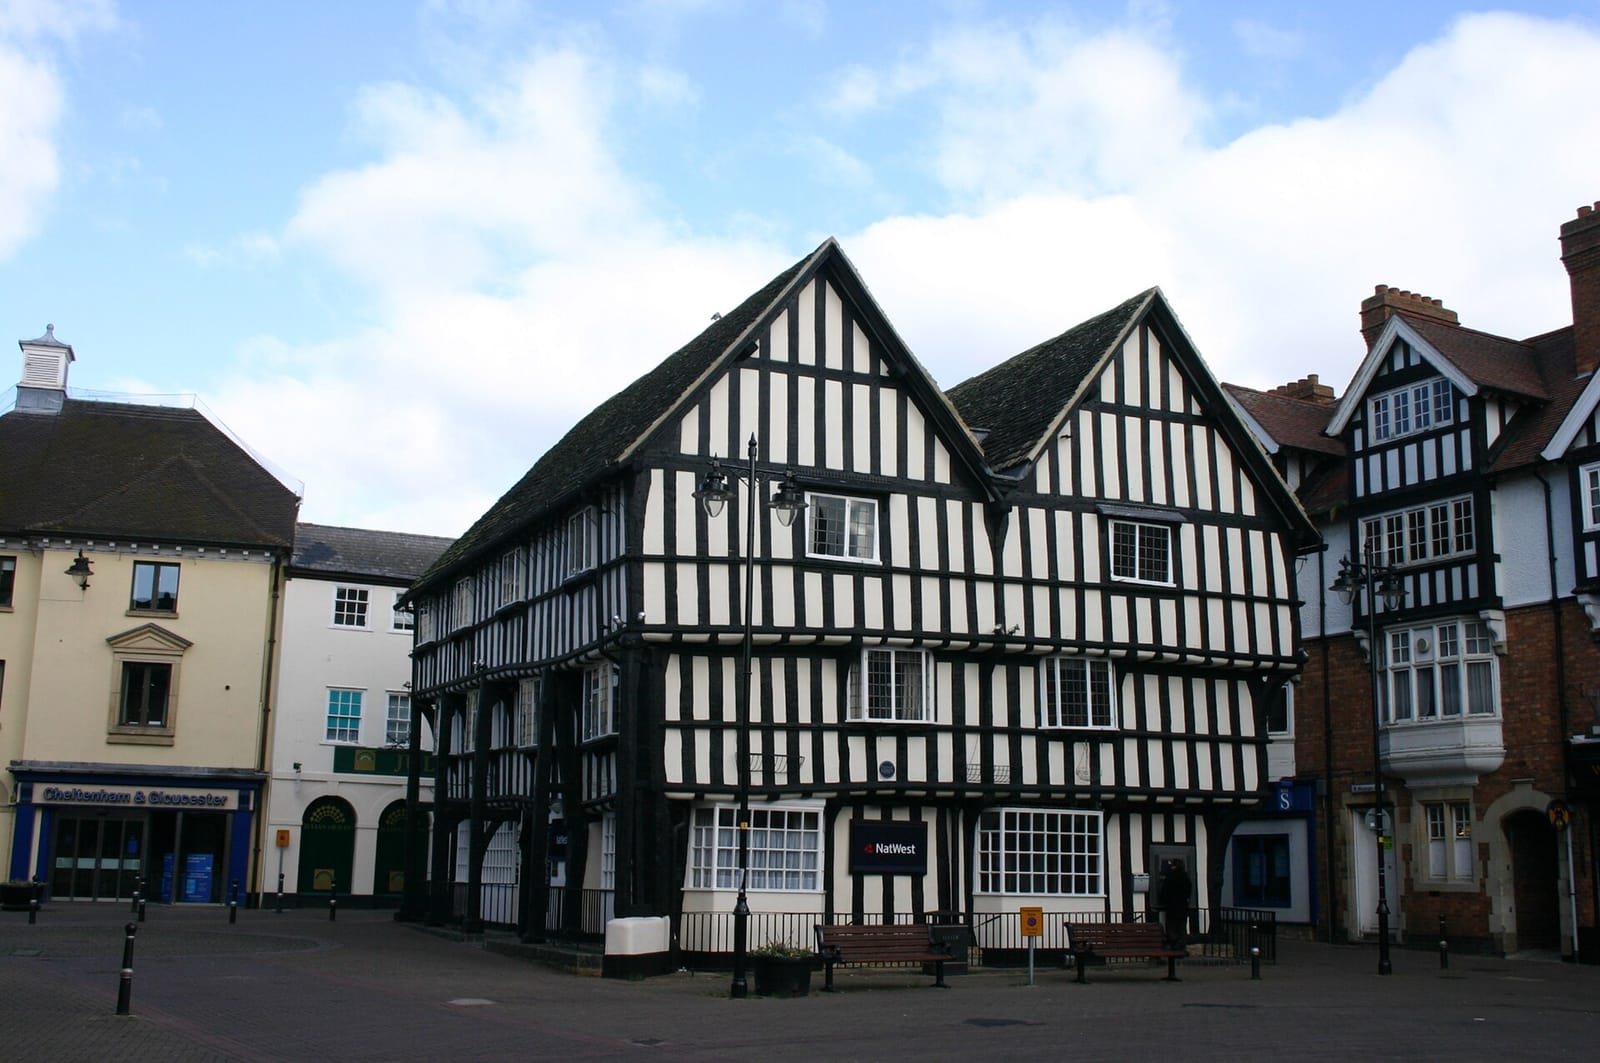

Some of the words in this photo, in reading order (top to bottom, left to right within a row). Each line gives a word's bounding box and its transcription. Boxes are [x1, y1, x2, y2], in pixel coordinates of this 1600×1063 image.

[43, 786, 131, 804] Cheltenham
[134, 789, 146, 804] &
[148, 790, 228, 806] Gloucester
[875, 842, 916, 855] NatWest
